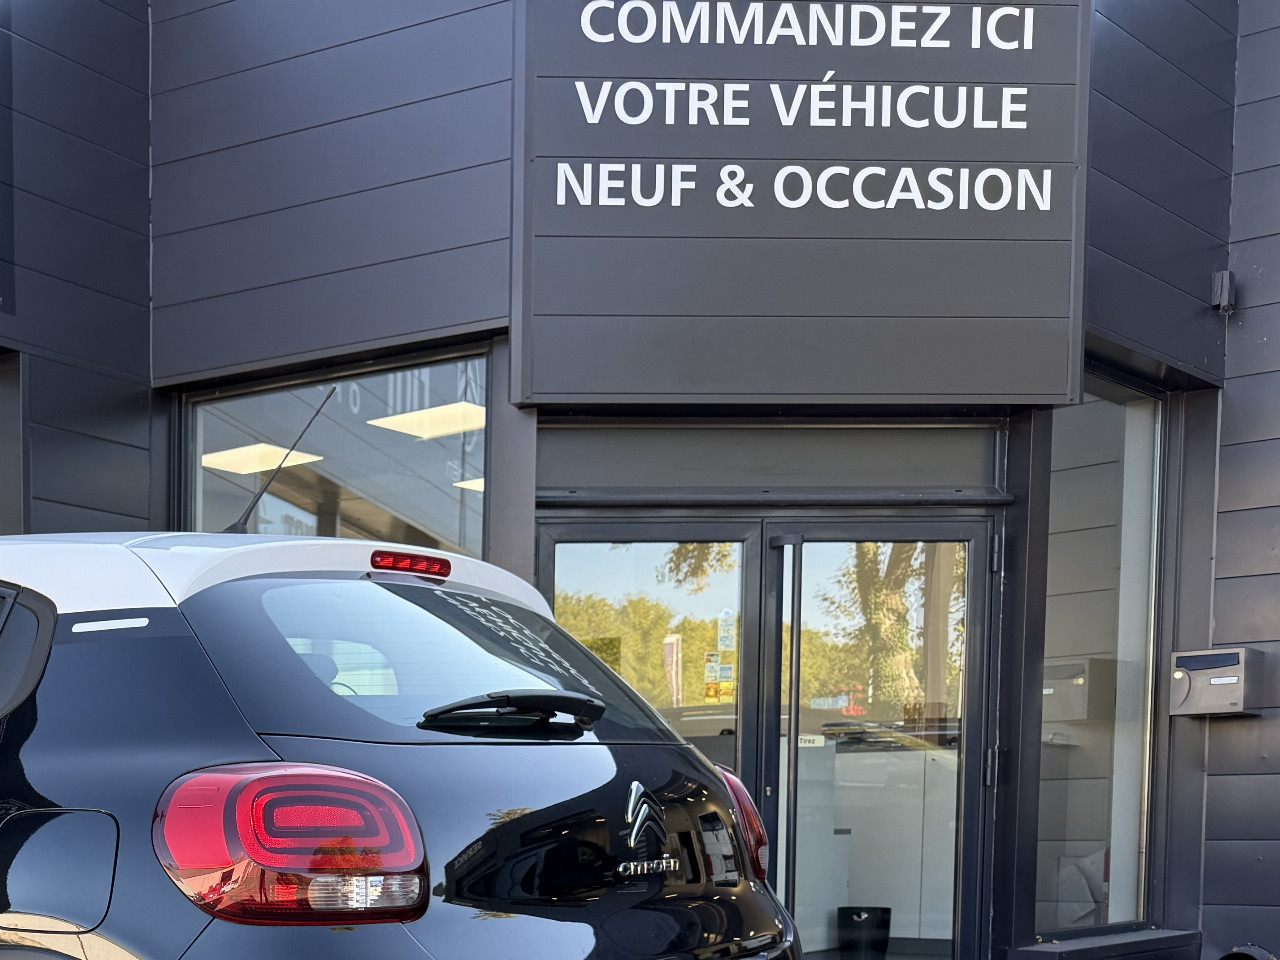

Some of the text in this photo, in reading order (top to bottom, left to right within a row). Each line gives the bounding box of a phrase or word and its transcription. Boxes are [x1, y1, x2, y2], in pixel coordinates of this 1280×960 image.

[580, 0, 1034, 50] COMMANDEZ ICI
[574, 71, 1028, 130] VOTRE VÉHICULE
[556, 163, 1052, 211] NEUF & OCCASION
[800, 737, 816, 745] Tirez
